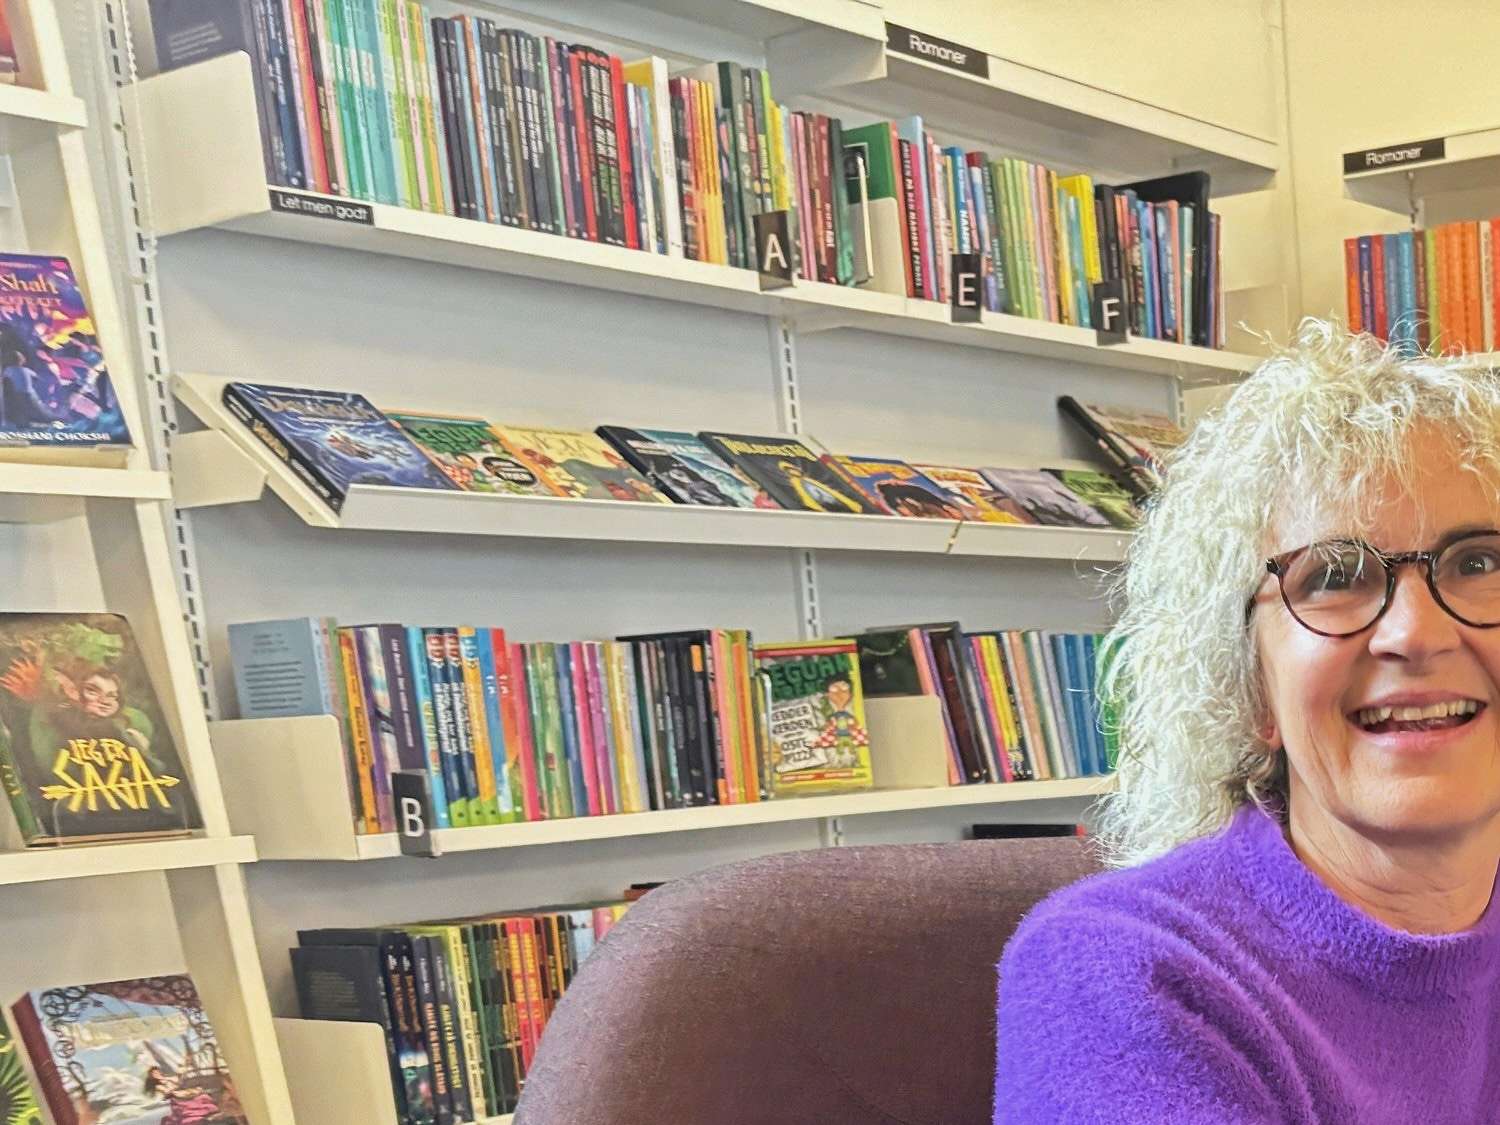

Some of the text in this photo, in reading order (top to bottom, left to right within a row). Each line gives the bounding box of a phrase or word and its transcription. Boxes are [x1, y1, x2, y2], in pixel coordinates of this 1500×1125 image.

[908, 35, 967, 66] Romaner
[1366, 146, 1422, 166] Romaner
[301, 199, 334, 213] men
[336, 204, 368, 220] godt
[764, 236, 788, 272] A
[958, 273, 977, 308] E
[1102, 297, 1121, 331] F
[769, 653, 851, 684] EGUAN
[53, 747, 171, 812] SAGA
[400, 797, 424, 837] B
